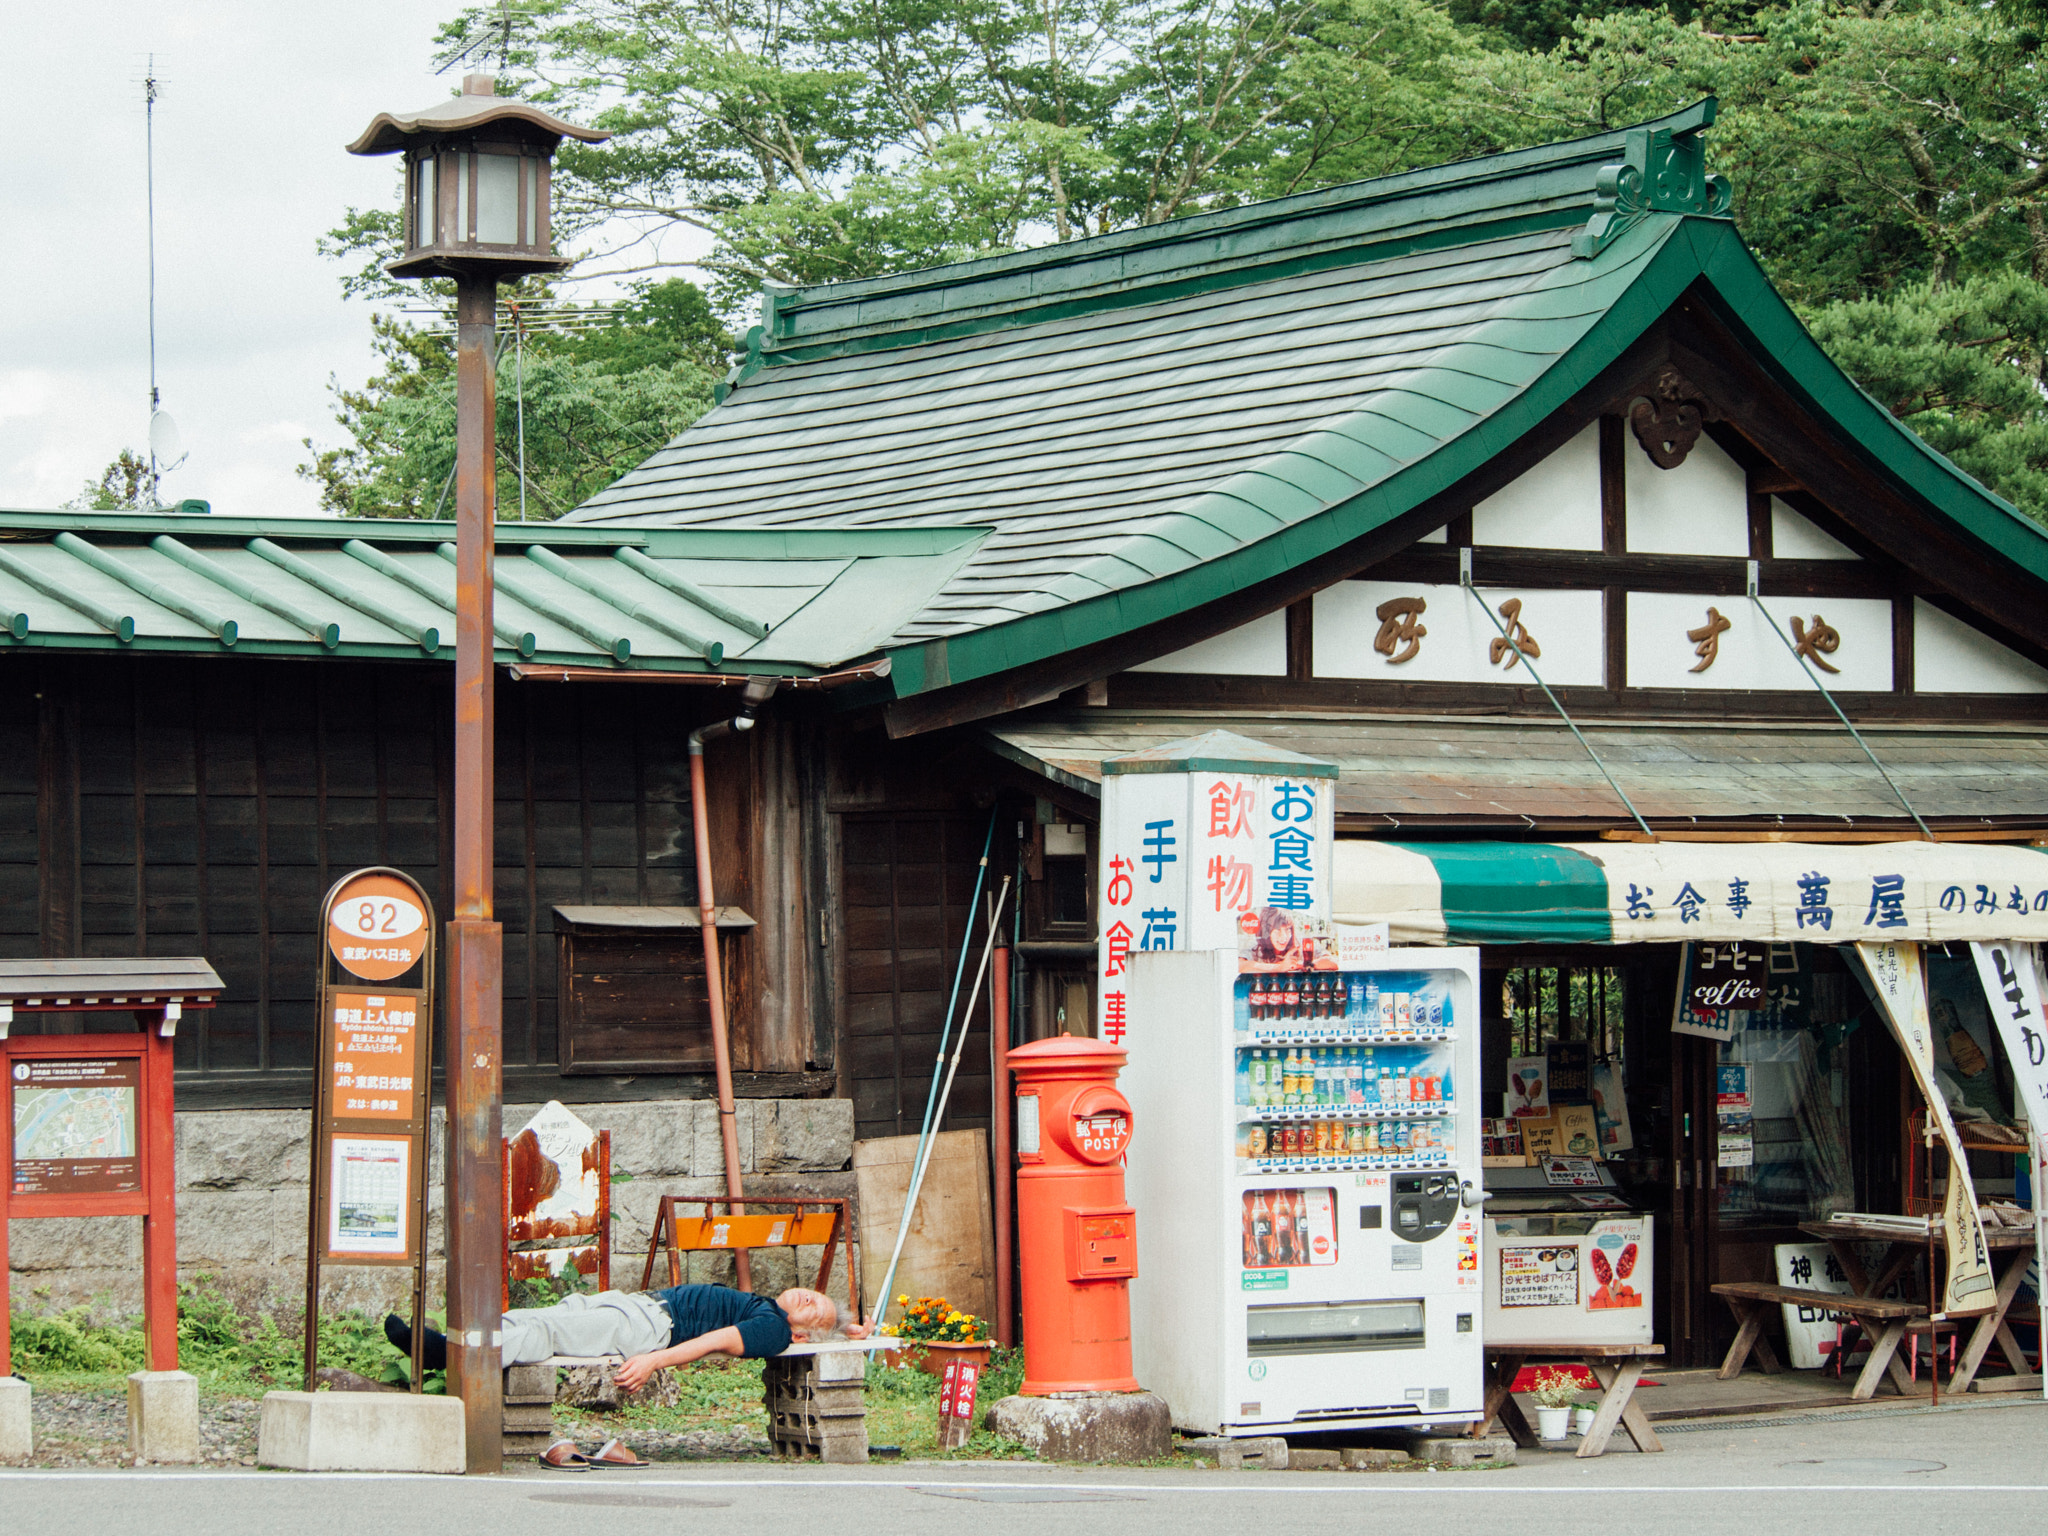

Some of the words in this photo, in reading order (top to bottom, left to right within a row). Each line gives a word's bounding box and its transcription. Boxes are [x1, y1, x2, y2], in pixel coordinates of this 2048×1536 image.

[1207, 780, 1255, 912] 飲物
[1267, 780, 1315, 910] お食事
[1626, 876, 1752, 924] お食事
[1795, 871, 1908, 931] 萬屋
[358, 902, 397, 933] 82
[342, 947, 412, 962] 東武バス日光
[1701, 947, 1762, 971] コーヒー
[1888, 948, 1897, 996] 日光山系
[1694, 979, 1761, 1005] coffee
[334, 1062, 353, 1073] 行先
[1084, 1137, 1119, 1151] POST
[1505, 1273, 1573, 1285] 日光生ゆばアイス
[941, 1365, 955, 1412] 消火栓
[957, 1366, 975, 1416] 消火栓
